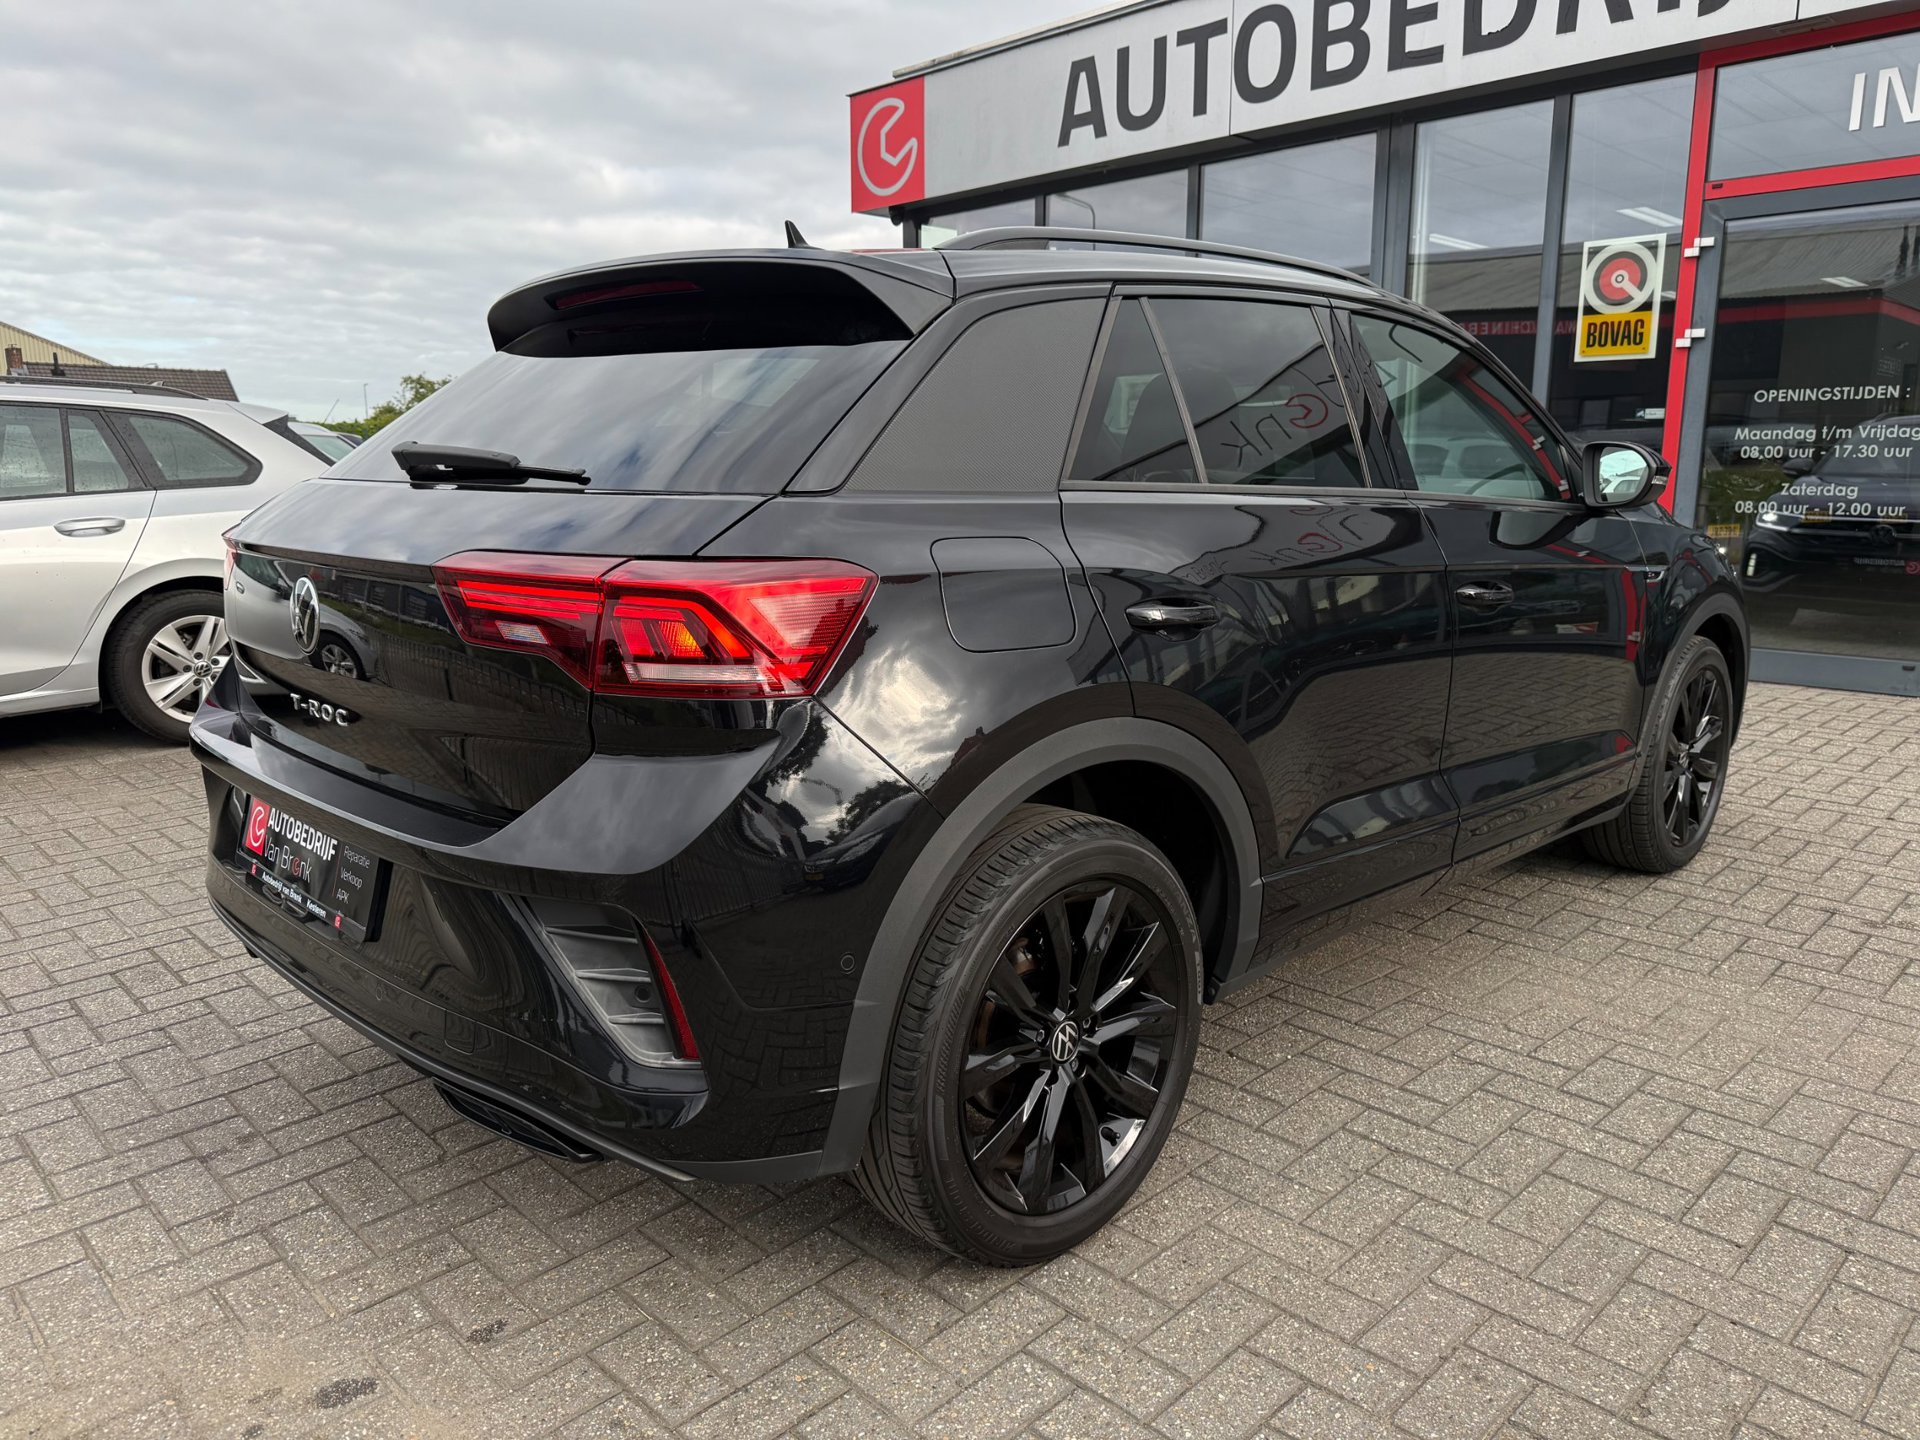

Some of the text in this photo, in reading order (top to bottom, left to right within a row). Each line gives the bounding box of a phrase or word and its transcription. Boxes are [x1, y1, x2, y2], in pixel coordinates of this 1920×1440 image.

[1057, 0, 1729, 148] AUTOBED
[1585, 318, 1645, 349] BOVAG
[1754, 384, 1901, 403] OPENINGSTIJDEN
[1734, 424, 1920, 443] Maandag t/m Vrijdag
[1788, 447, 1816, 459] uur
[1833, 445, 1879, 458] 17.30
[1883, 446, 1913, 459] uur
[1780, 482, 1859, 500] Zaterdag
[1734, 500, 1778, 514] 08.00
[1782, 503, 1809, 516] uur
[1827, 502, 1872, 516] 12.00
[1876, 504, 1906, 517] uur
[290, 692, 349, 727] T-ROC
[267, 807, 338, 862] AUTOBEDRIJF
[263, 834, 280, 864] Van
[340, 866, 363, 890] Verkoop
[335, 888, 350, 905] APK
